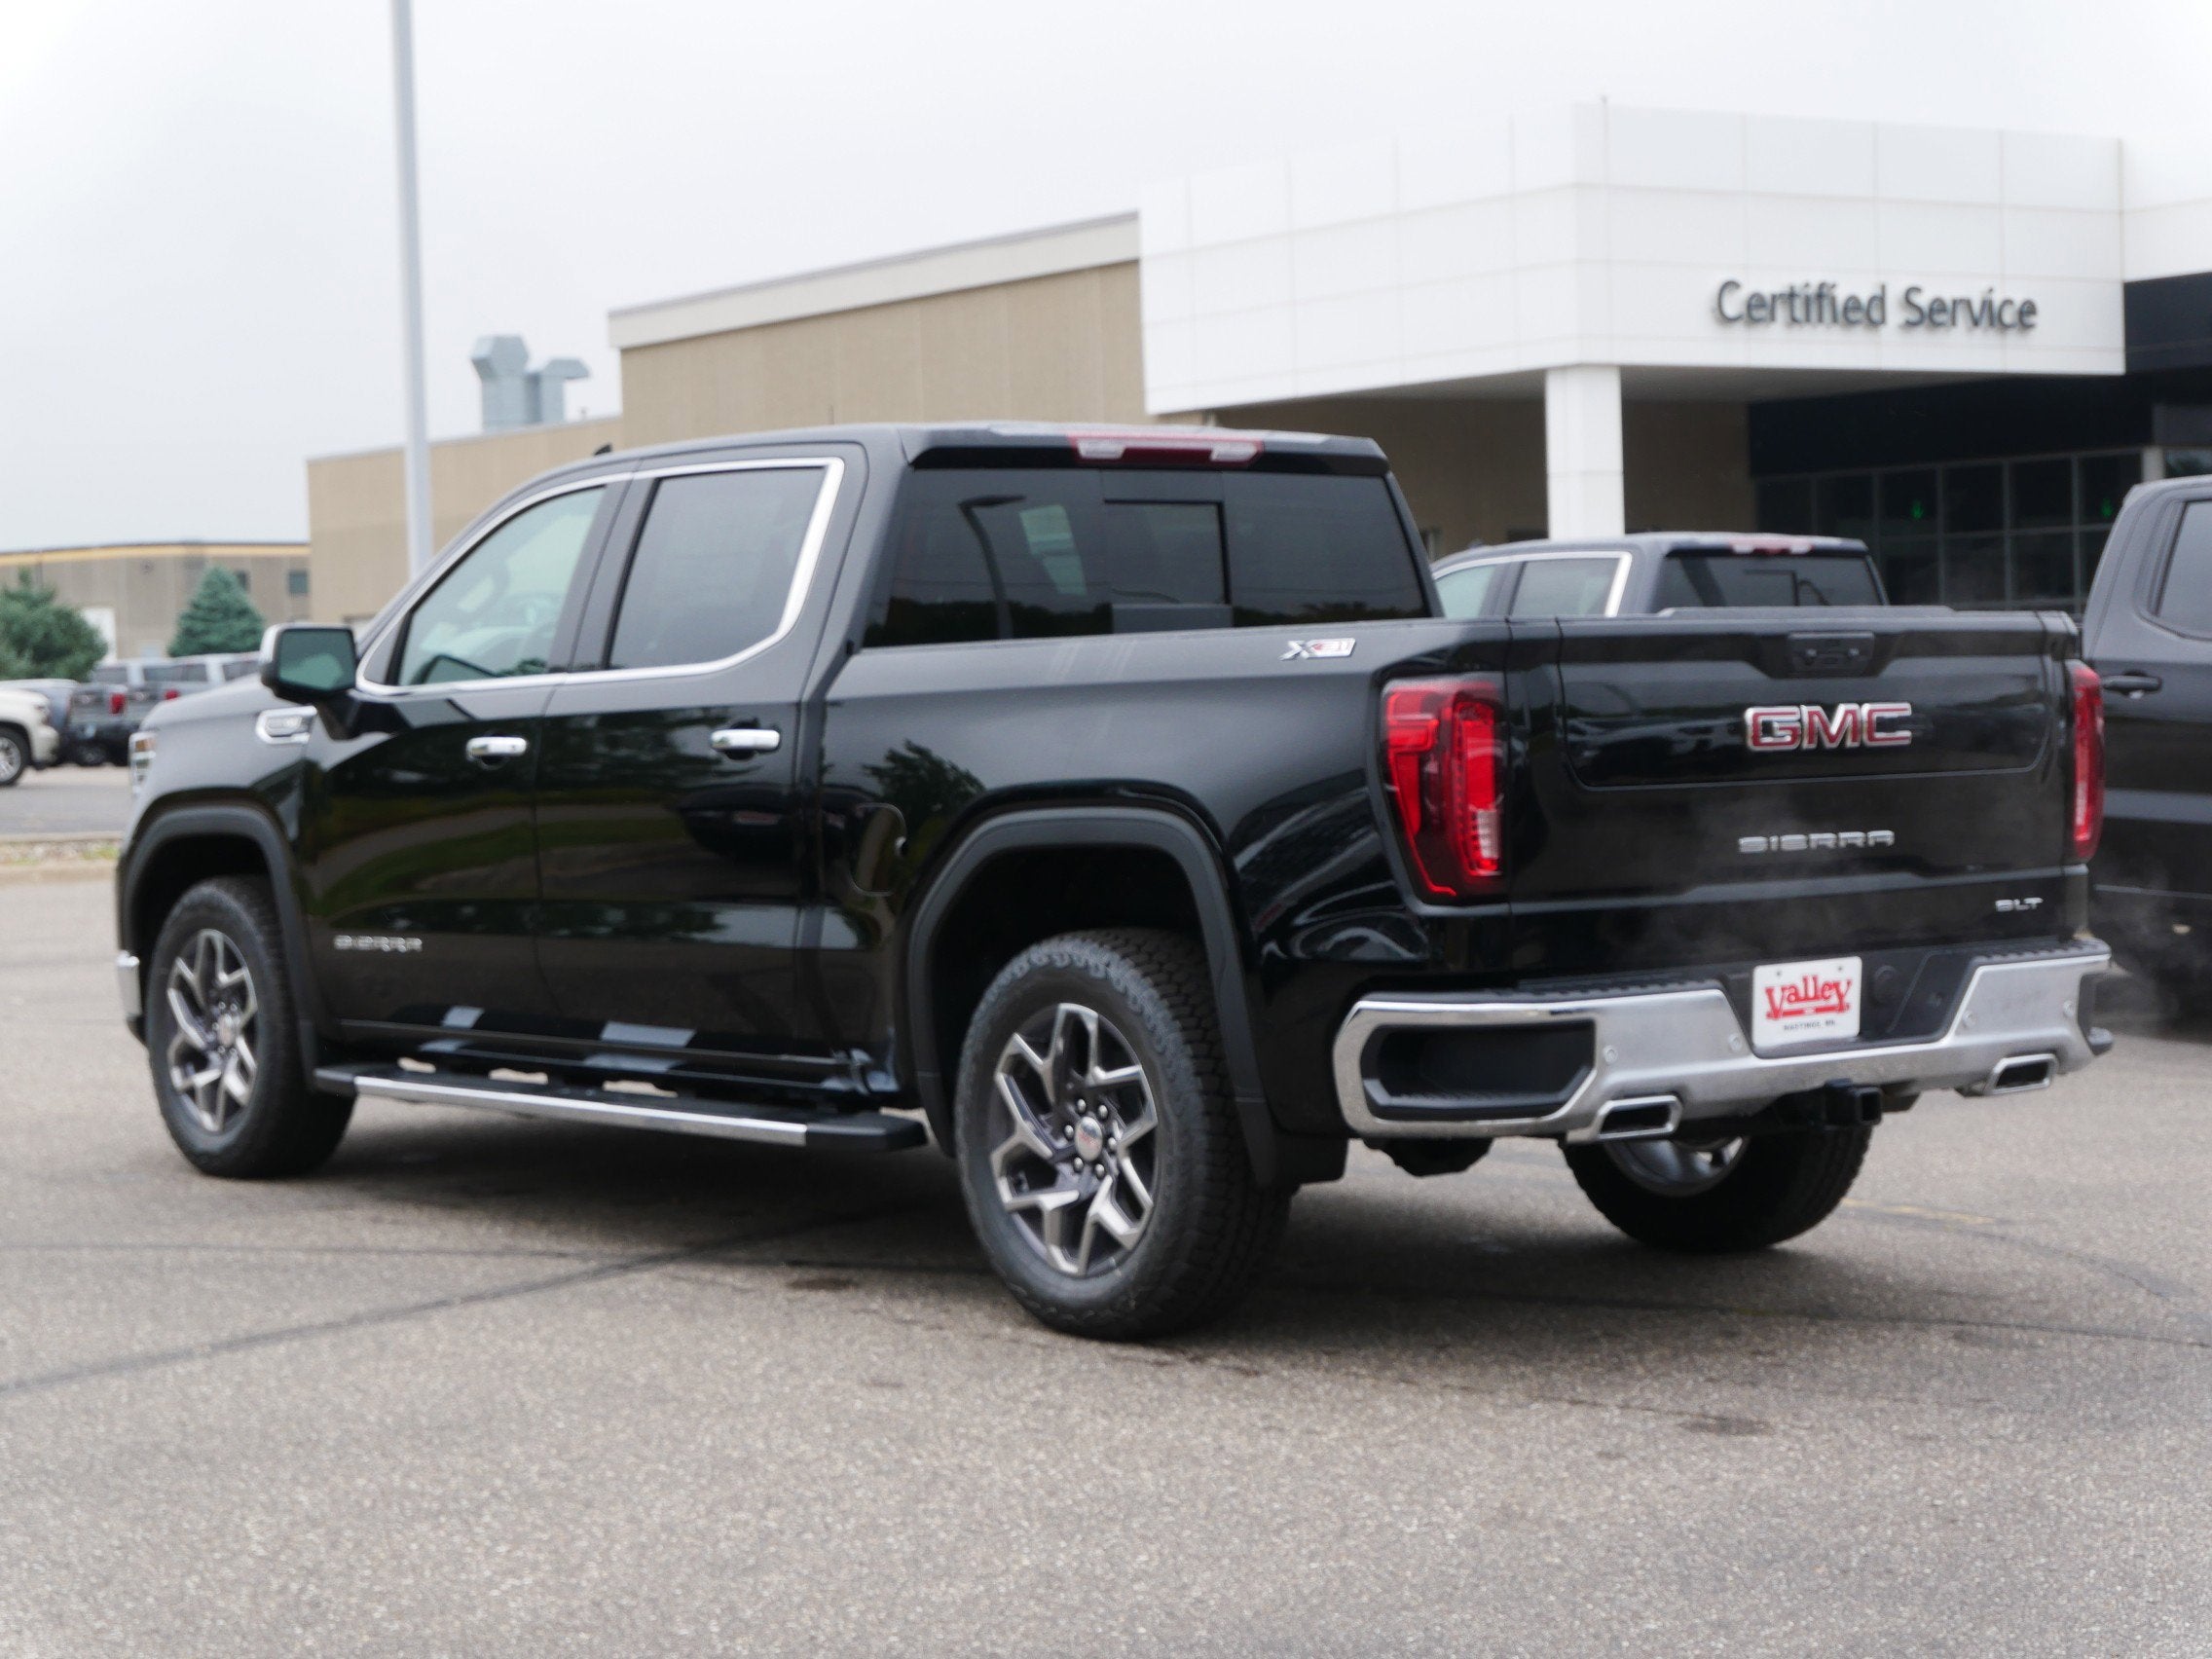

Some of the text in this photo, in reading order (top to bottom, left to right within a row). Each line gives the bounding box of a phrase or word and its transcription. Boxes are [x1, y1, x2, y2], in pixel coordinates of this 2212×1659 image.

[1716, 279, 2039, 331] Certified Service
[1745, 701, 1912, 751] GMC
[1739, 830, 1895, 854] SIERRA
[1995, 897, 2044, 912] SLT
[1764, 975, 1854, 1021] Valley
